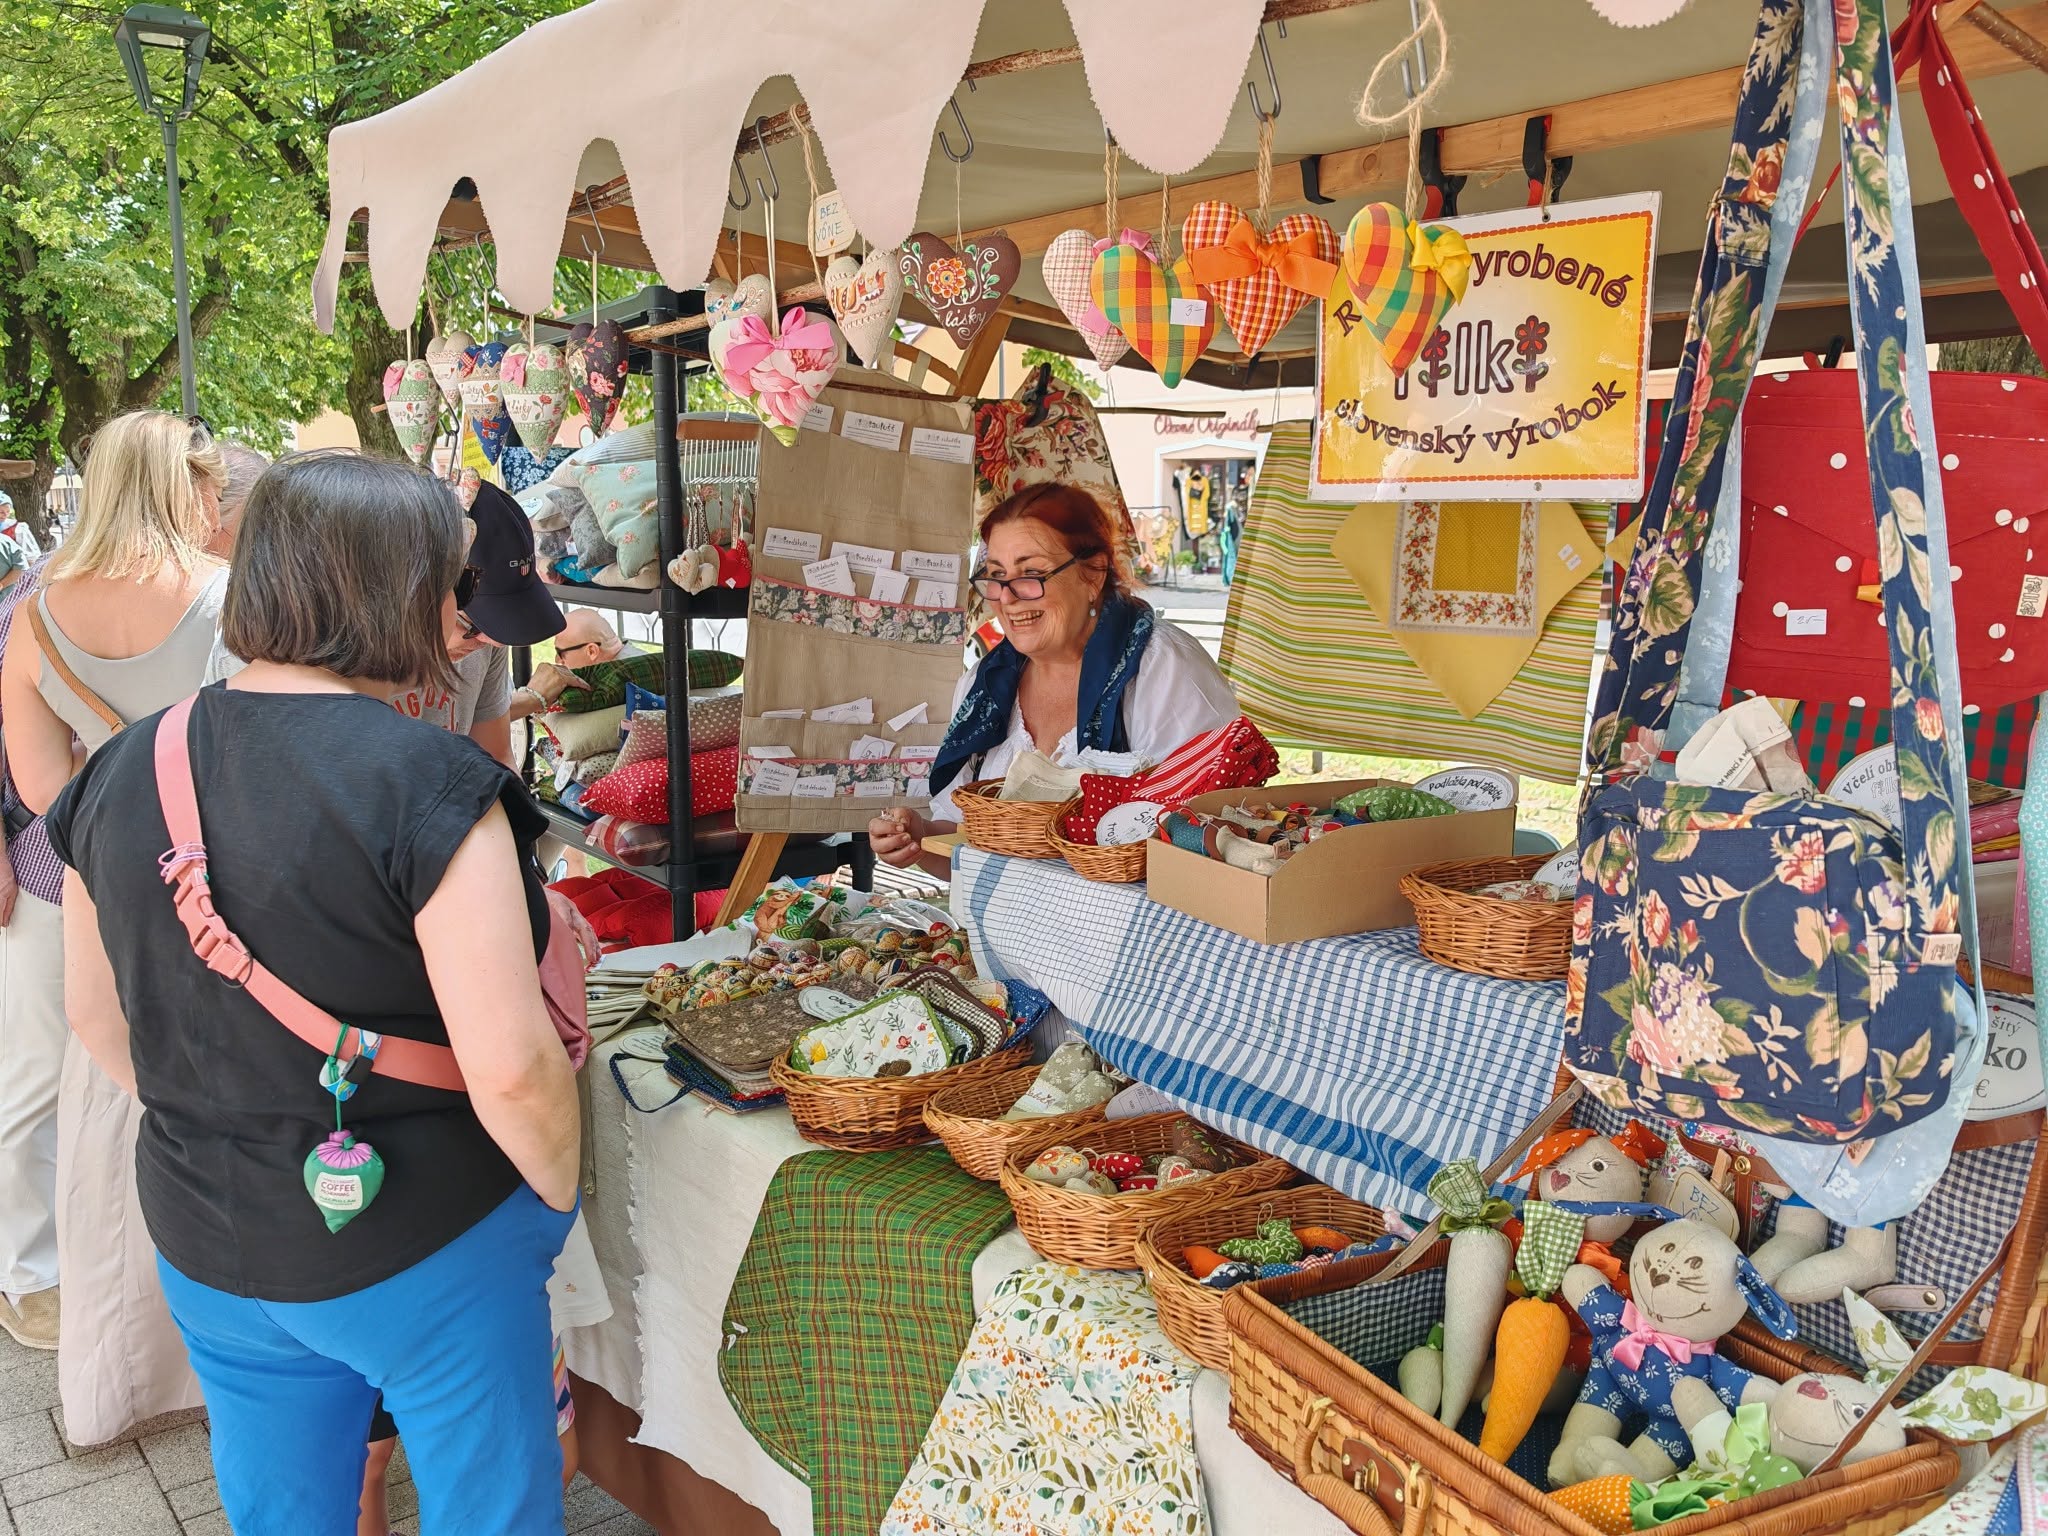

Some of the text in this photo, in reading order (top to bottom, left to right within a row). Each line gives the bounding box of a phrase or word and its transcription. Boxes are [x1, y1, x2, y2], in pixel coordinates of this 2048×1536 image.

[820, 202, 839, 219] BEZ
[1472, 243, 1634, 308] yrobené
[1483, 380, 1627, 460] výrobok
[1990, 1015, 2022, 1038] šitý
[320, 1181, 356, 1192] COFFEE
[1689, 1185, 1720, 1222] BEZ
